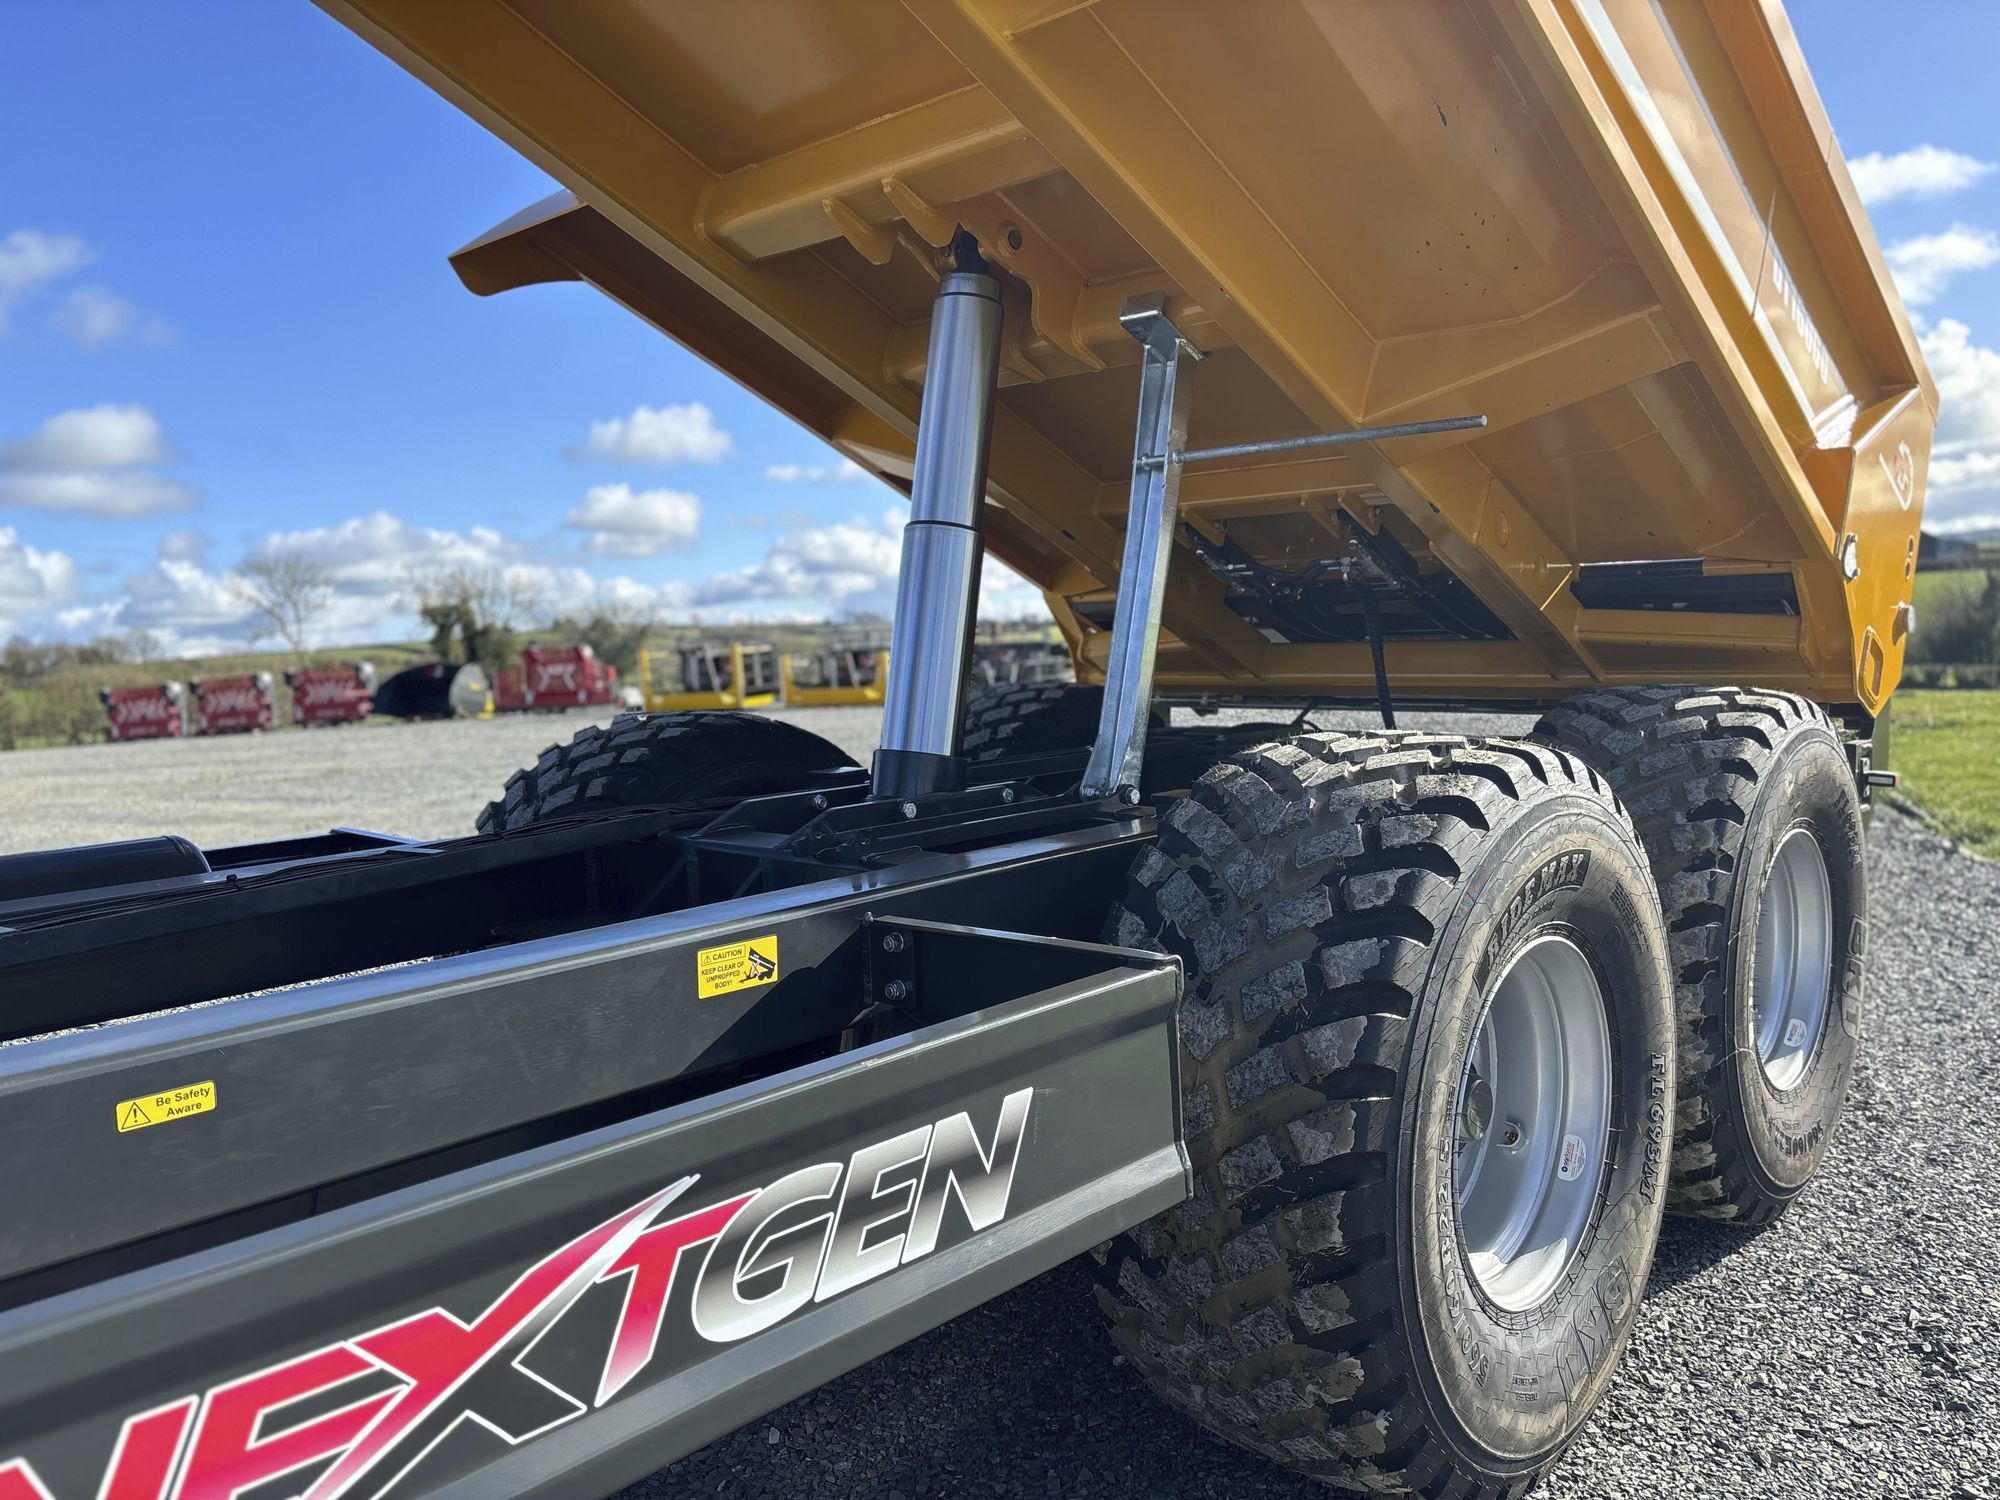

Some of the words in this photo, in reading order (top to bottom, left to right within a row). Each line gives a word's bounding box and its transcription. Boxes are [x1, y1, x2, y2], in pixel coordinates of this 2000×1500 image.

[712, 949, 743, 961] CAUTION
[702, 967, 716, 976] KEEP
[717, 963, 736, 972] CLEAR
[706, 970, 741, 983] UNPROPPED
[156, 1097, 171, 1107] Be
[175, 1087, 210, 1102] Safety
[166, 1102, 202, 1117] Aware
